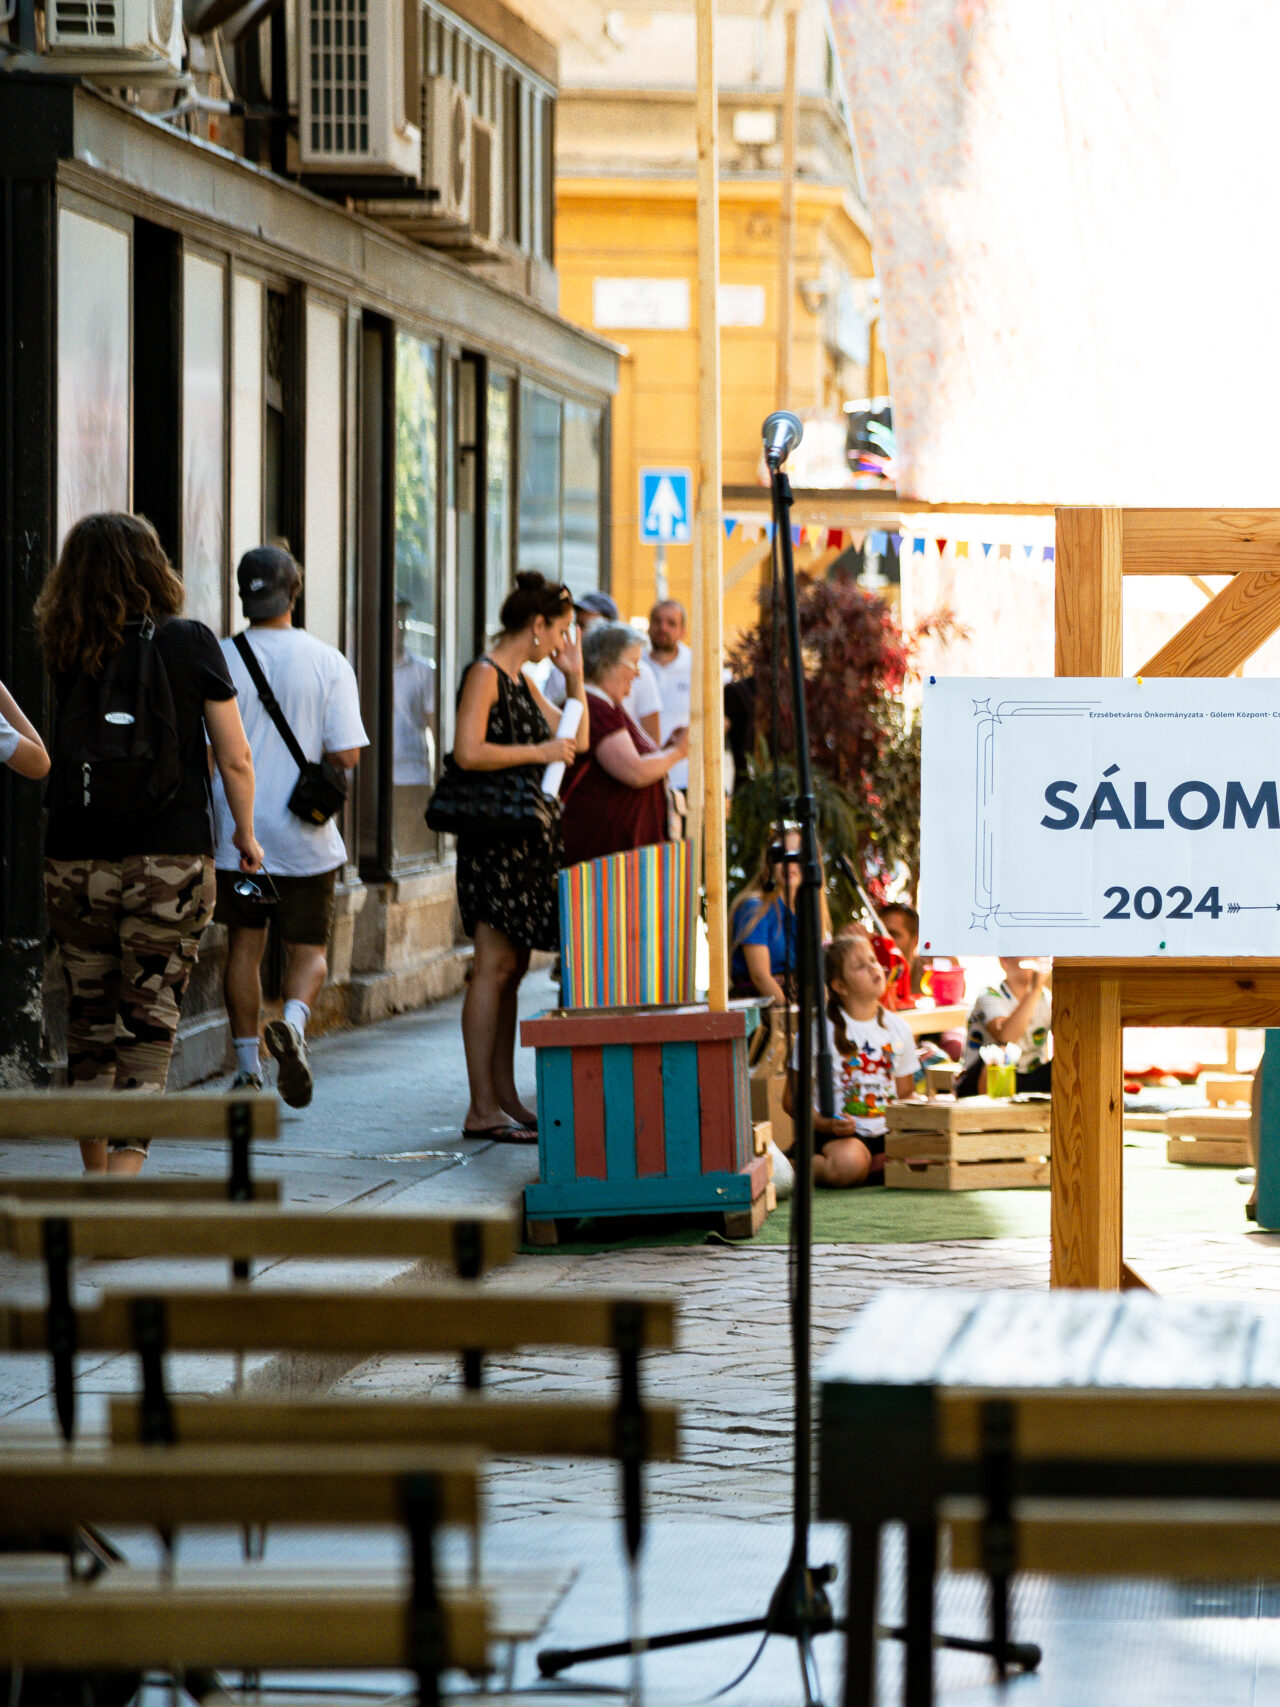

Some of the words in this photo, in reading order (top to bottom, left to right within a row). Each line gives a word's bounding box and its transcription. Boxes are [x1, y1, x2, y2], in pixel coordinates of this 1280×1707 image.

[1089, 711, 1143, 719] Erzsébetváros
[1144, 710, 1204, 720] Önkormányzata
[1210, 711, 1235, 719] Gólem
[1040, 763, 1280, 830] SÁLOM
[1103, 886, 1223, 920] 2024
